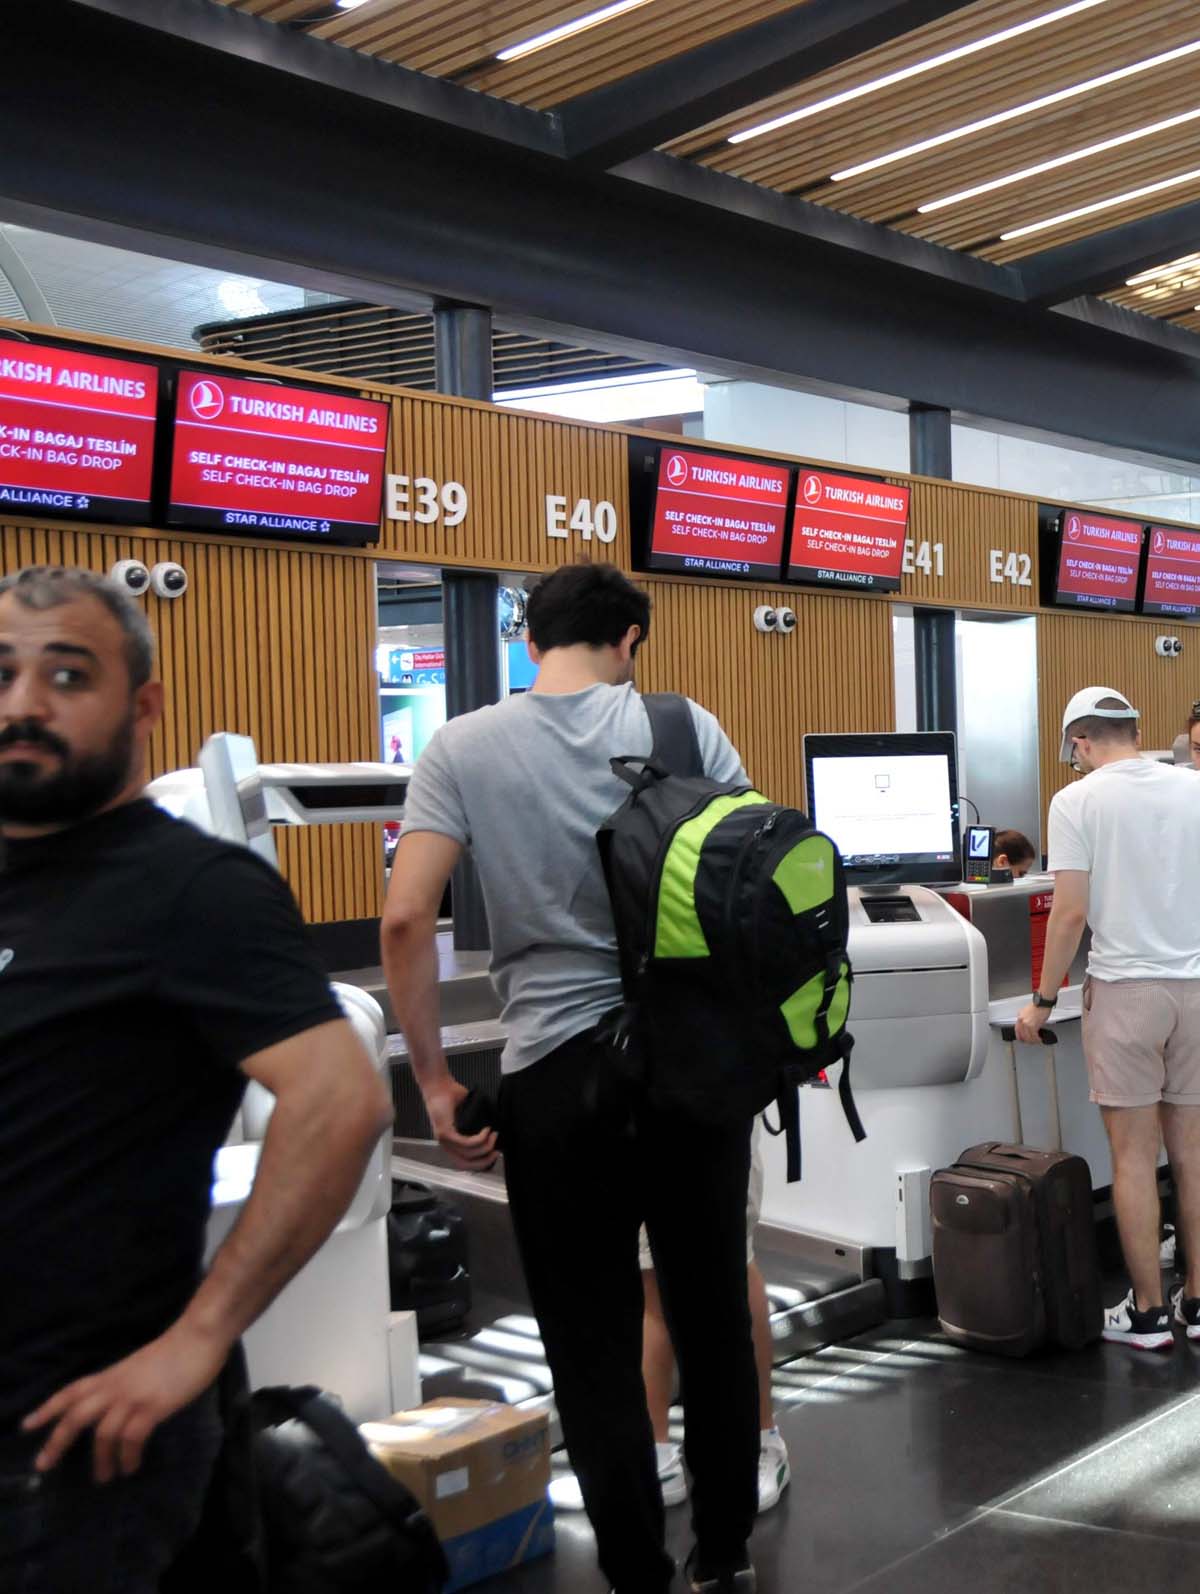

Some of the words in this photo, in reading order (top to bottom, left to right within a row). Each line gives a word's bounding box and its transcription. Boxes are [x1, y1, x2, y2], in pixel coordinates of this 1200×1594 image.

[0, 359, 51, 383] KISH
[57, 369, 145, 398] AIRLINES
[230, 396, 304, 422] TURKISH
[308, 409, 378, 433] AIRLINES
[34, 430, 83, 448] BAGAJ
[87, 438, 137, 455] TESLİM
[47, 450, 78, 465] BAG
[82, 454, 122, 470] DROP
[190, 451, 222, 465] SELF
[225, 456, 285, 473] CHECK-IN
[288, 464, 327, 479] BAGAJ
[330, 469, 369, 484] TESLİM
[203, 469, 232, 484] SELF
[236, 474, 295, 491] CHECK-IN
[298, 480, 321, 494] BAG
[325, 484, 357, 497] DROP
[691, 466, 736, 486] TURKISH
[738, 474, 783, 493] AIRLINES
[0, 489, 73, 507] ALLIANCE
[386, 473, 468, 527] E39
[825, 486, 864, 503] TURKISH
[865, 493, 904, 511] AIRLINES
[226, 512, 257, 525] STAR
[259, 515, 317, 531] ALLIANCE
[545, 494, 618, 543] E40
[665, 510, 685, 522] SELF
[686, 513, 723, 527] CHECK-IN
[672, 525, 691, 535] SELF
[692, 527, 728, 539] CHECK-IN
[730, 532, 745, 542] BAG
[747, 534, 768, 545] DROP
[802, 526, 819, 537] SELF
[1083, 525, 1110, 540] TURKISH
[1111, 529, 1138, 544] AIRLINES
[807, 539, 823, 549] SELF
[857, 546, 870, 557] BAG
[871, 548, 890, 559] DROP
[902, 538, 944, 577] E41
[684, 558, 704, 568] STAR
[705, 560, 741, 572] ALLIANCE
[817, 569, 834, 580] STAR
[836, 572, 866, 584] ALLIANCE
[990, 549, 1032, 586] E42
